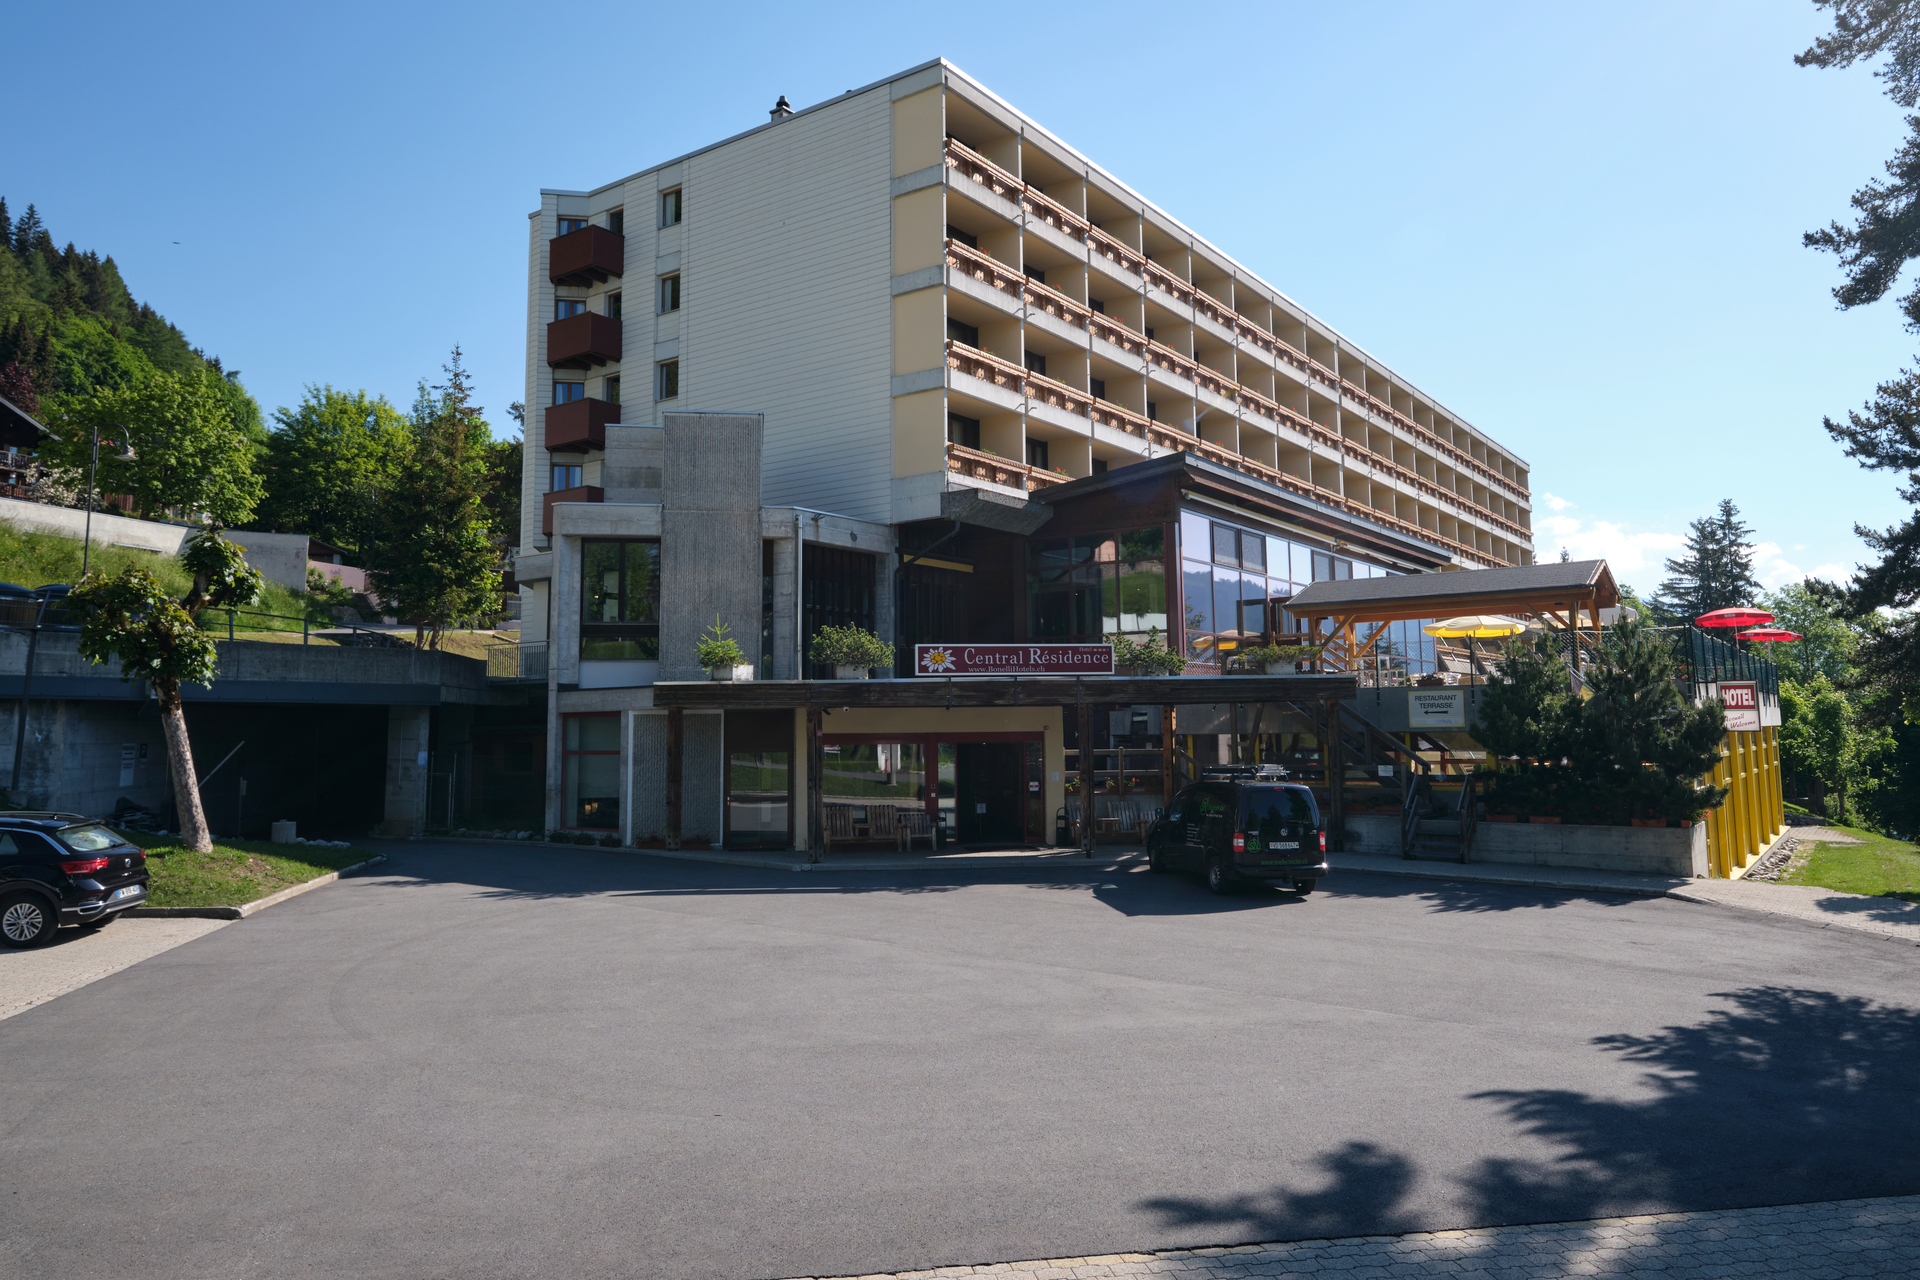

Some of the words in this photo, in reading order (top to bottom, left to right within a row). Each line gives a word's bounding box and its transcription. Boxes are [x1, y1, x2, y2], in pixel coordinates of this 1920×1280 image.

[964, 648, 1023, 664] Central
[1029, 648, 1109, 664] Résidence
[1722, 689, 1755, 706] HOTEL
[1730, 720, 1756, 729] Welcome
